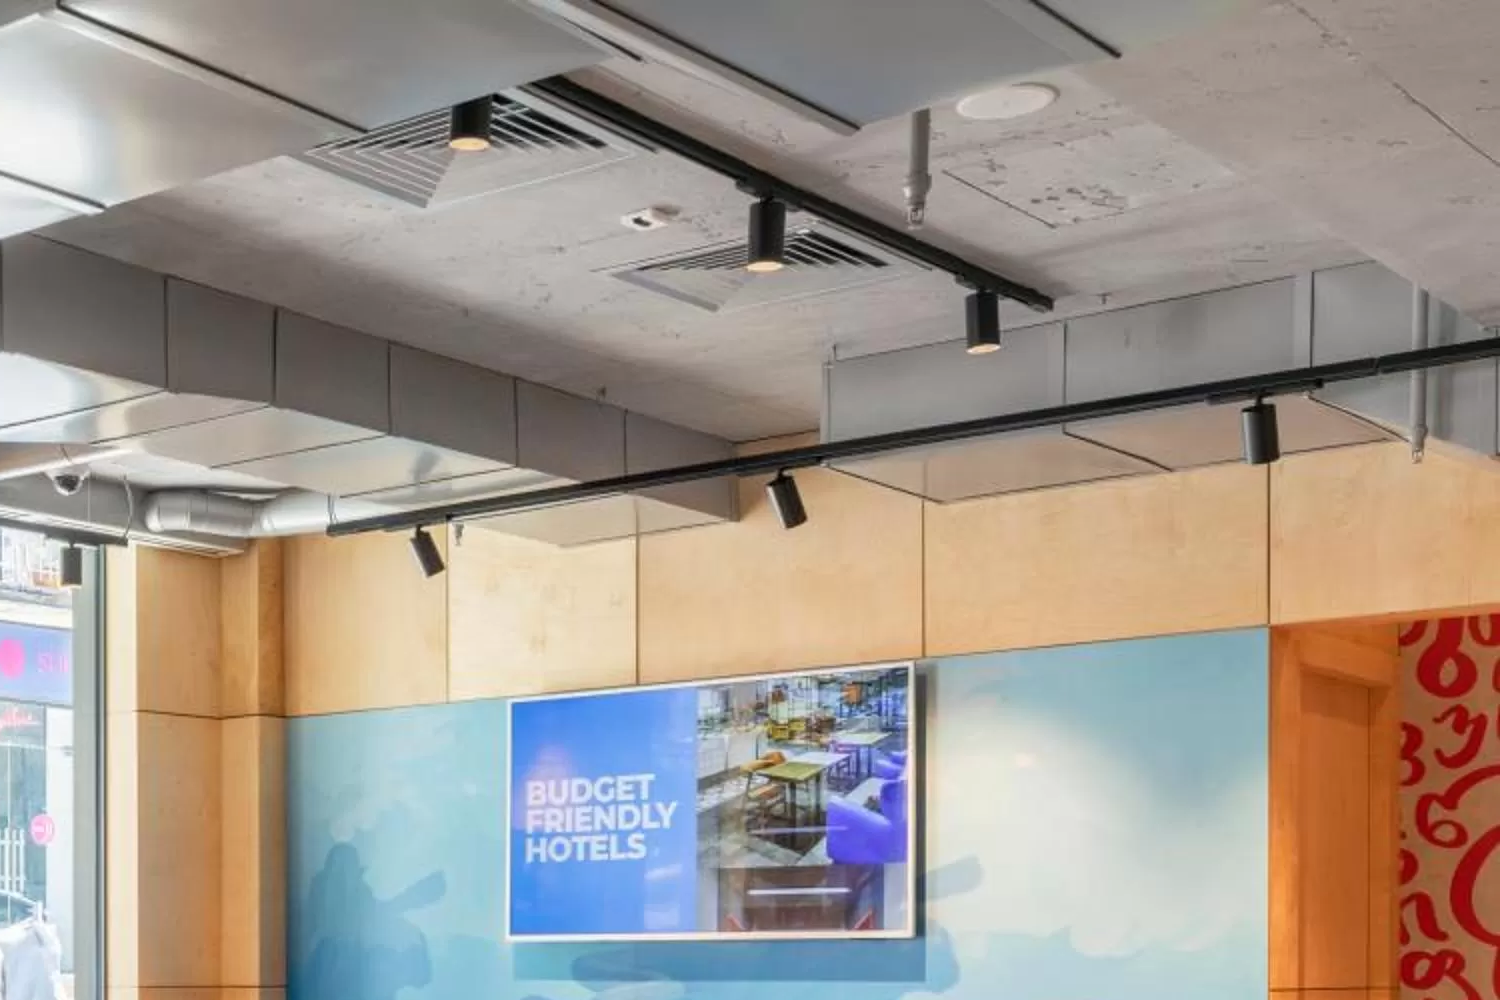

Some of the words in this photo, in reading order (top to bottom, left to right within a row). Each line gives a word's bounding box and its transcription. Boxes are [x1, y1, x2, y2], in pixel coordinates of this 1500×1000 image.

[526, 773, 656, 806] BUDGET
[526, 800, 678, 834] FRIENDLY
[525, 832, 647, 864] HOTELS
